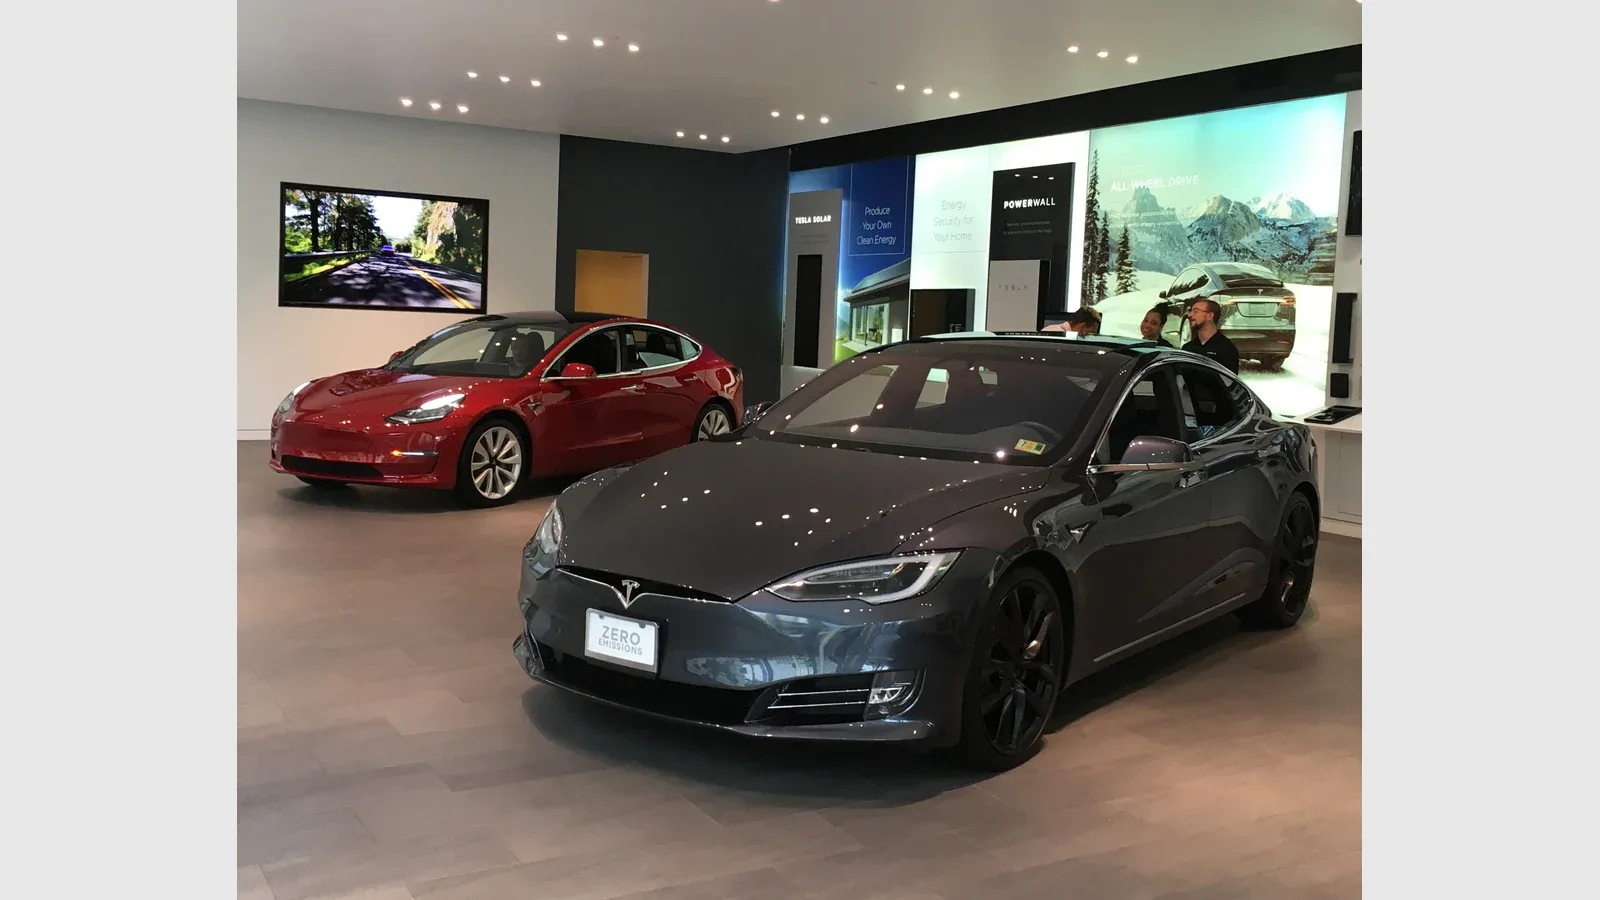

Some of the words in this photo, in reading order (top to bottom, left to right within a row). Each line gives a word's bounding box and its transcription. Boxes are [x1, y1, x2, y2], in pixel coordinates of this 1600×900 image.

[1168, 174, 1199, 187] DRIVE
[941, 200, 966, 211] Energy
[1003, 197, 1056, 209] POWERWALL
[864, 206, 891, 216] Produce
[795, 216, 812, 225] TESLA
[812, 214, 832, 223] SOLAR
[862, 221, 876, 230] Your
[876, 220, 892, 230] Own
[933, 216, 961, 227] Security
[964, 214, 974, 225] for
[856, 236, 874, 246] Clean
[874, 234, 897, 246] Energy
[950, 232, 973, 242] Home
[602, 625, 640, 646] ZERO
[598, 638, 643, 656] EMISSIONS
